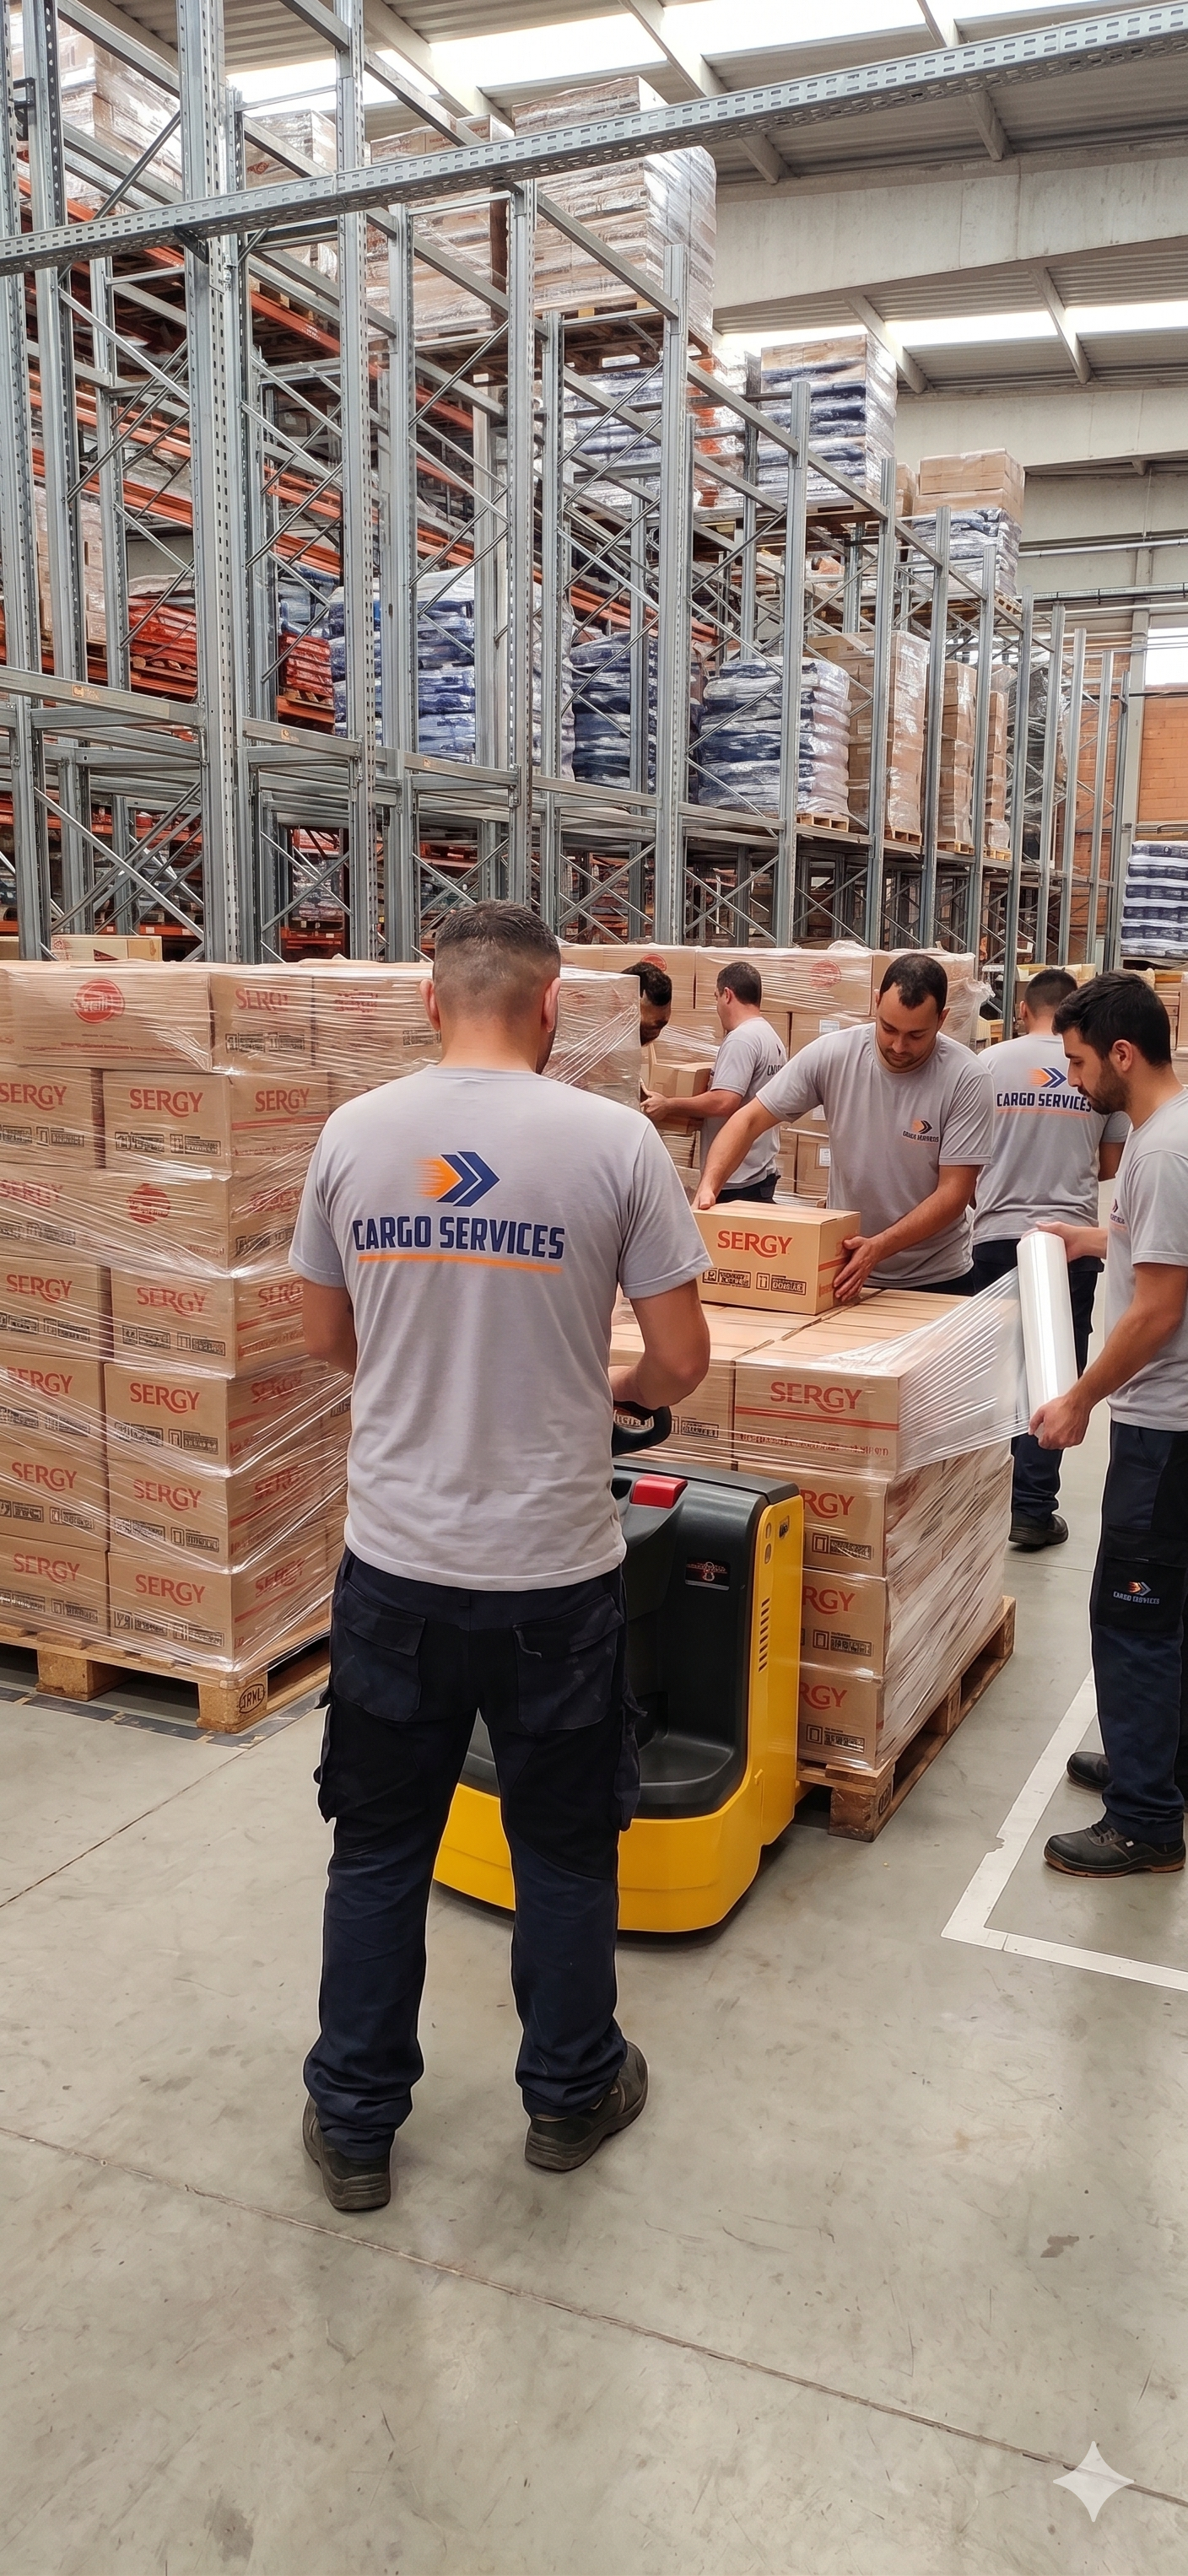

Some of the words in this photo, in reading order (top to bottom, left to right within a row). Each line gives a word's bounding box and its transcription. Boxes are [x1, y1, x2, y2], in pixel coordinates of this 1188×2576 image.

[0, 1082, 68, 1112] SERGY
[129, 1088, 203, 1118] SERGY
[255, 1088, 310, 1114] SERGY
[996, 1092, 1035, 1107] CARGO
[1038, 1093, 1092, 1113] SERVICES
[352, 1215, 431, 1251] CARGO
[439, 1215, 565, 1260] SERVICES
[717, 1230, 792, 1258] SERGY
[6, 1274, 73, 1303] SERGY
[137, 1286, 207, 1318] SERGY
[258, 1279, 304, 1308] SERG
[130, 1382, 200, 1415] SERGY
[770, 1381, 862, 1415] SERGY
[12, 1462, 78, 1492] SERGY
[132, 1479, 202, 1512] SERGY
[800, 1489, 856, 1519] RGY
[14, 1553, 80, 1583] SERGY
[135, 1574, 206, 1606] SERGY
[802, 1586, 856, 1614] RGY
[798, 1681, 848, 1711] RGY
